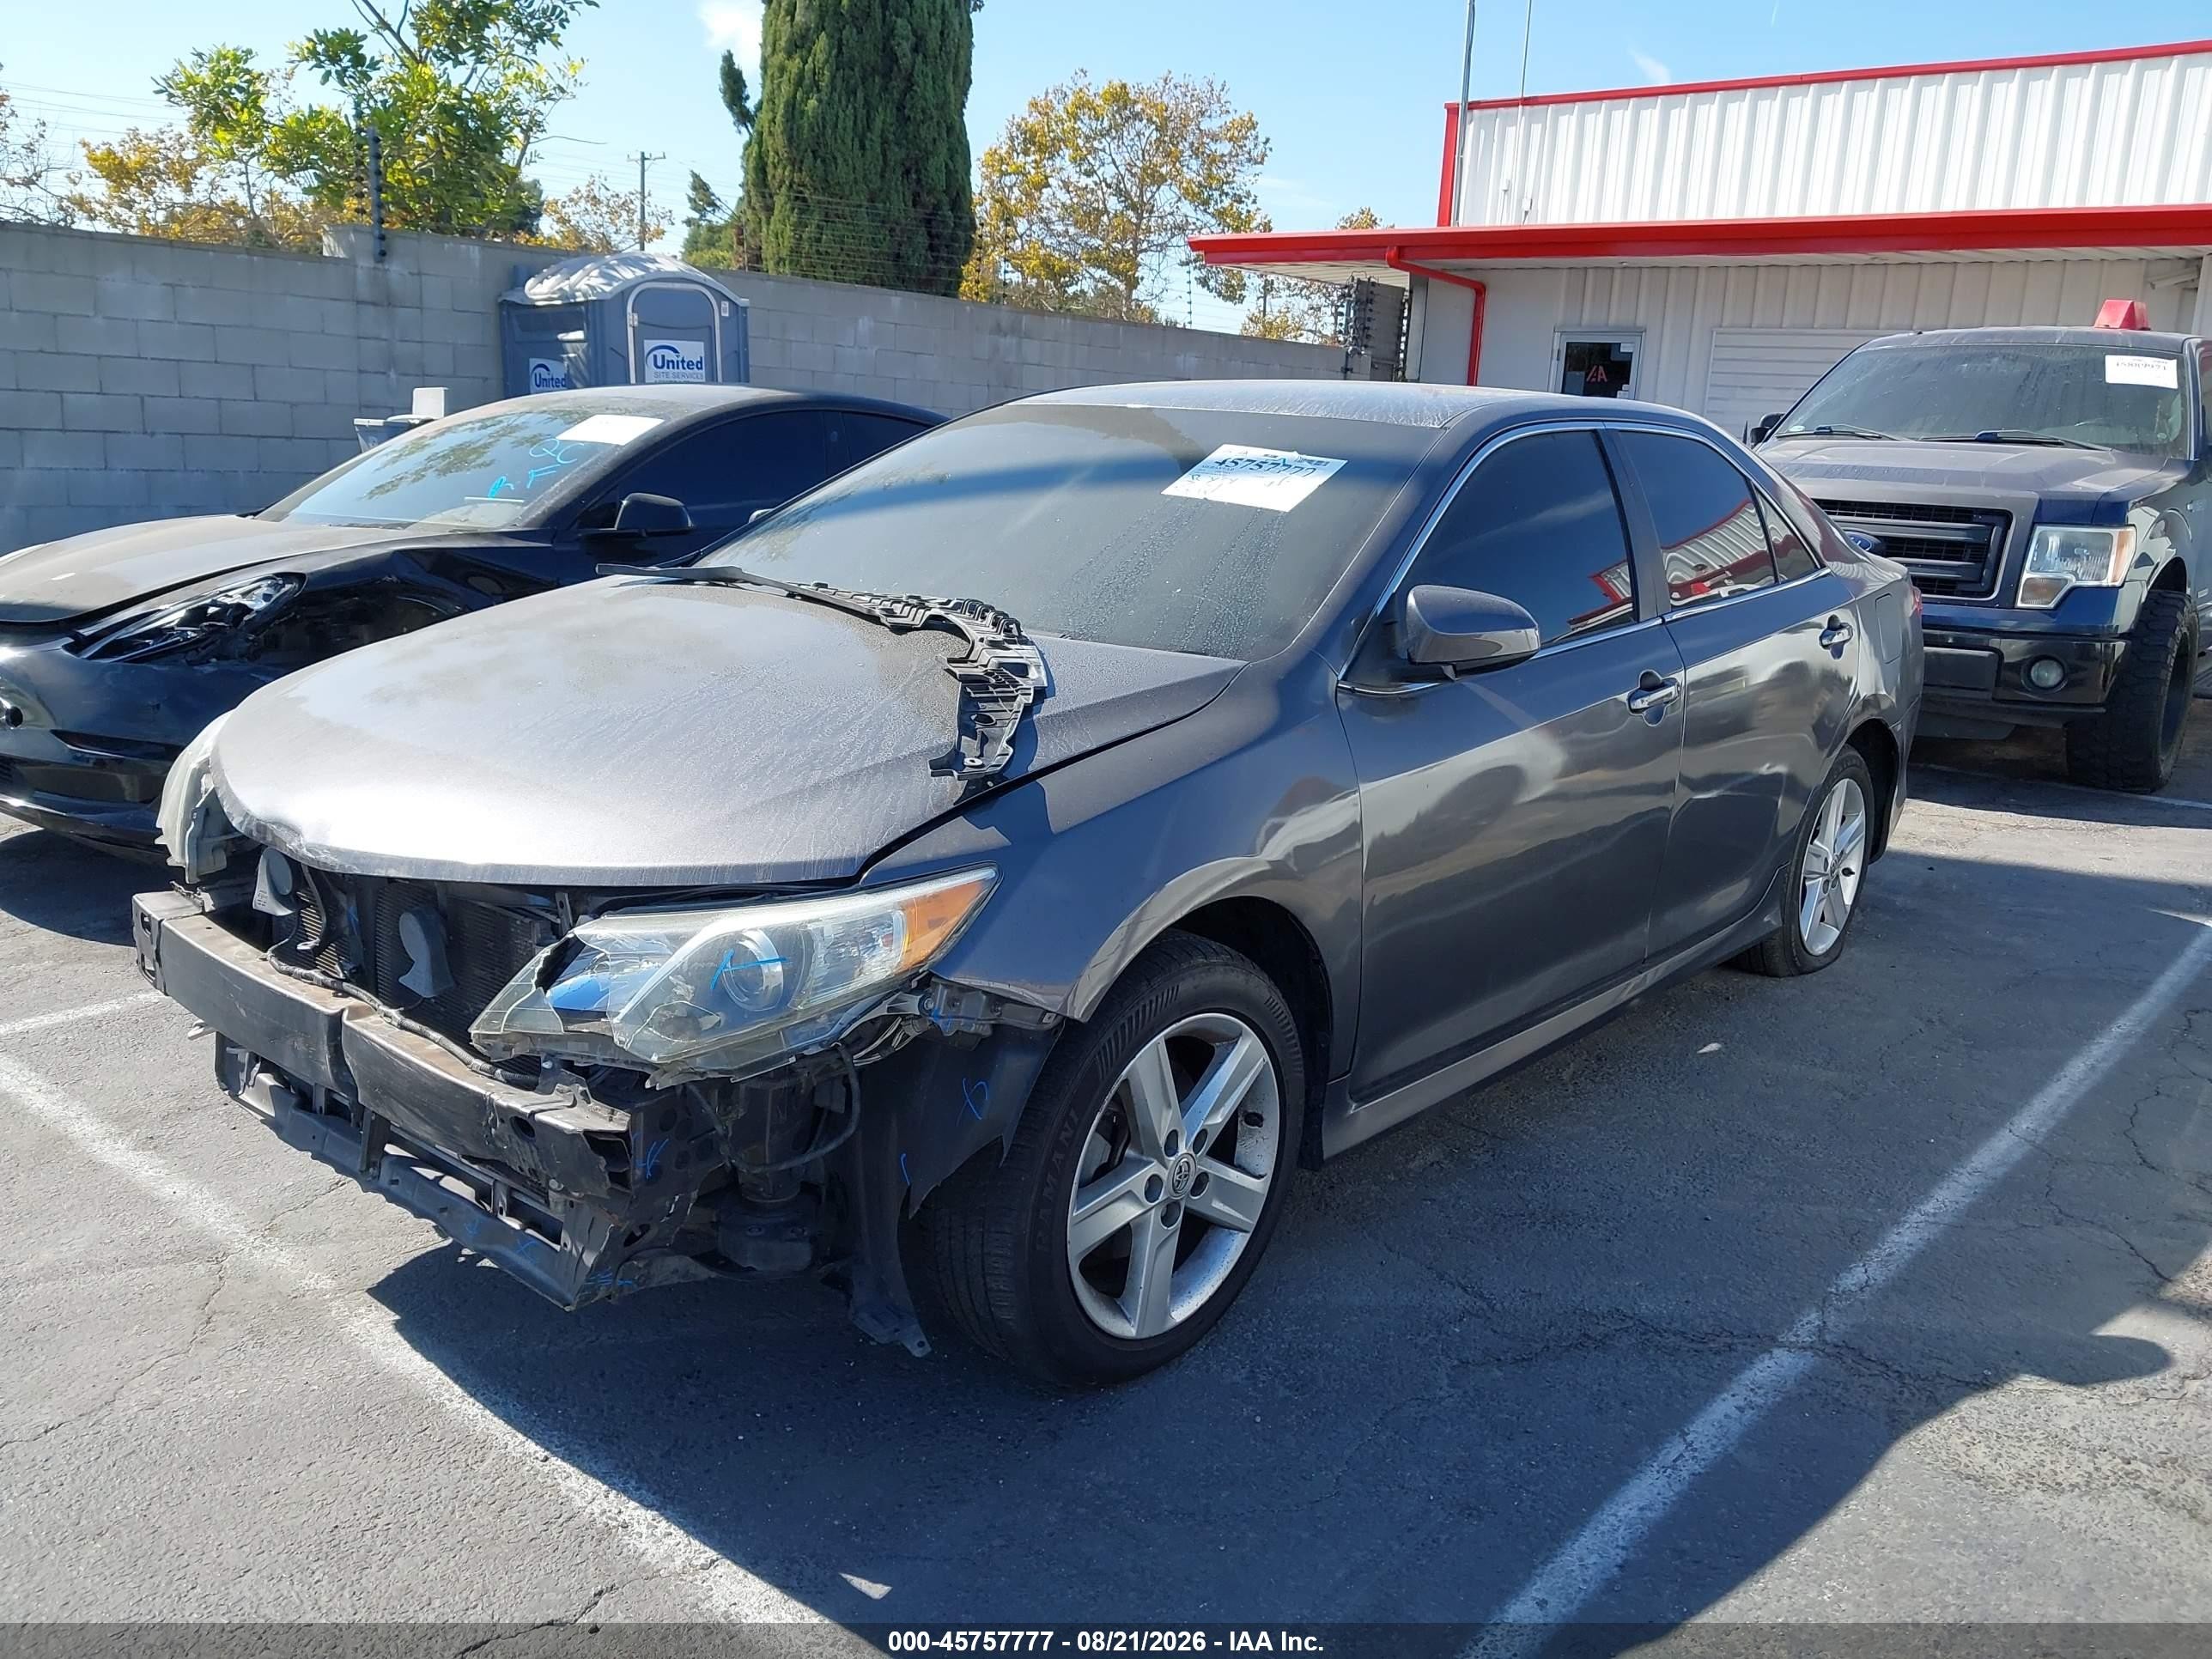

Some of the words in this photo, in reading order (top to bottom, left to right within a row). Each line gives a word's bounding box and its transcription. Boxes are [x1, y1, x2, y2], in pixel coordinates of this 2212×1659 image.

[653, 354, 703, 371] United
[534, 372, 568, 388] United
[653, 371, 669, 380] SITE
[529, 438, 585, 465] QC
[1214, 457, 1317, 478] 45757777
